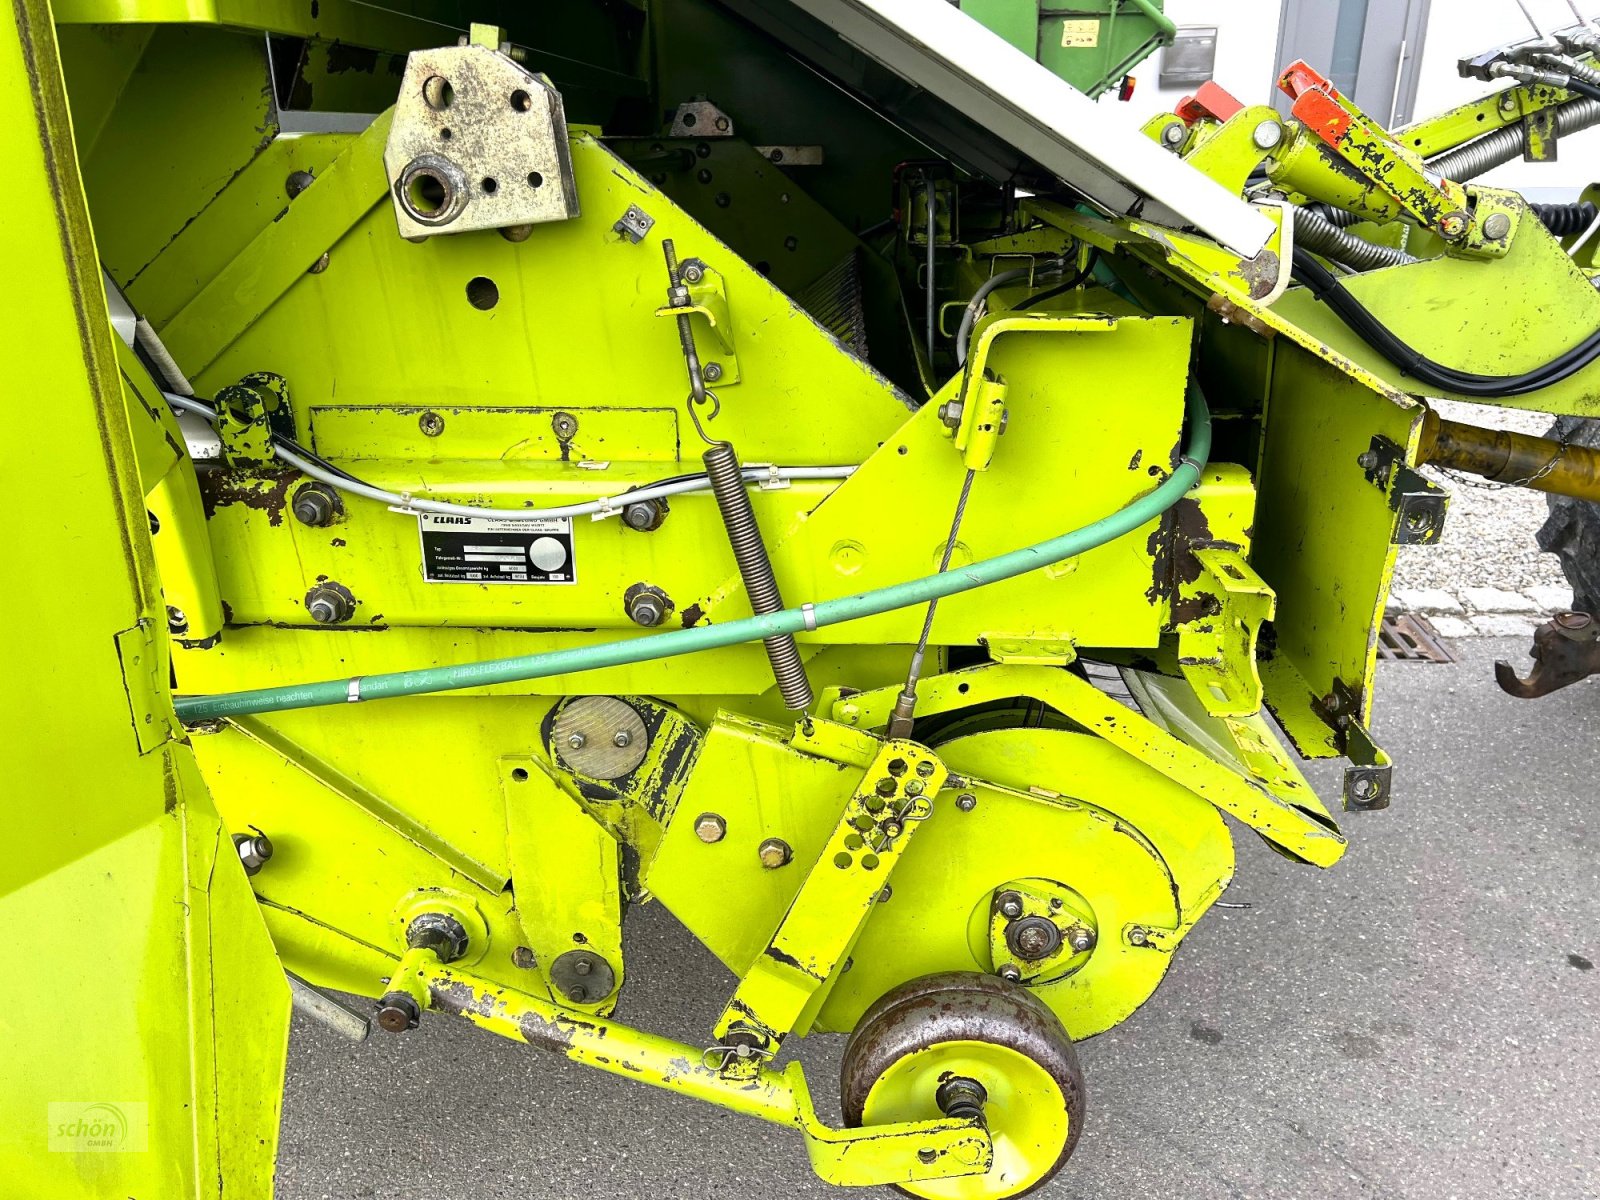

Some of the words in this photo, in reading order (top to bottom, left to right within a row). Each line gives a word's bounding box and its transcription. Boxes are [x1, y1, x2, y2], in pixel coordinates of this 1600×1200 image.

[433, 516, 472, 525] CLAAS
[193, 703, 209, 714] 125
[453, 659, 523, 679] NIRO-FLEXBALL
